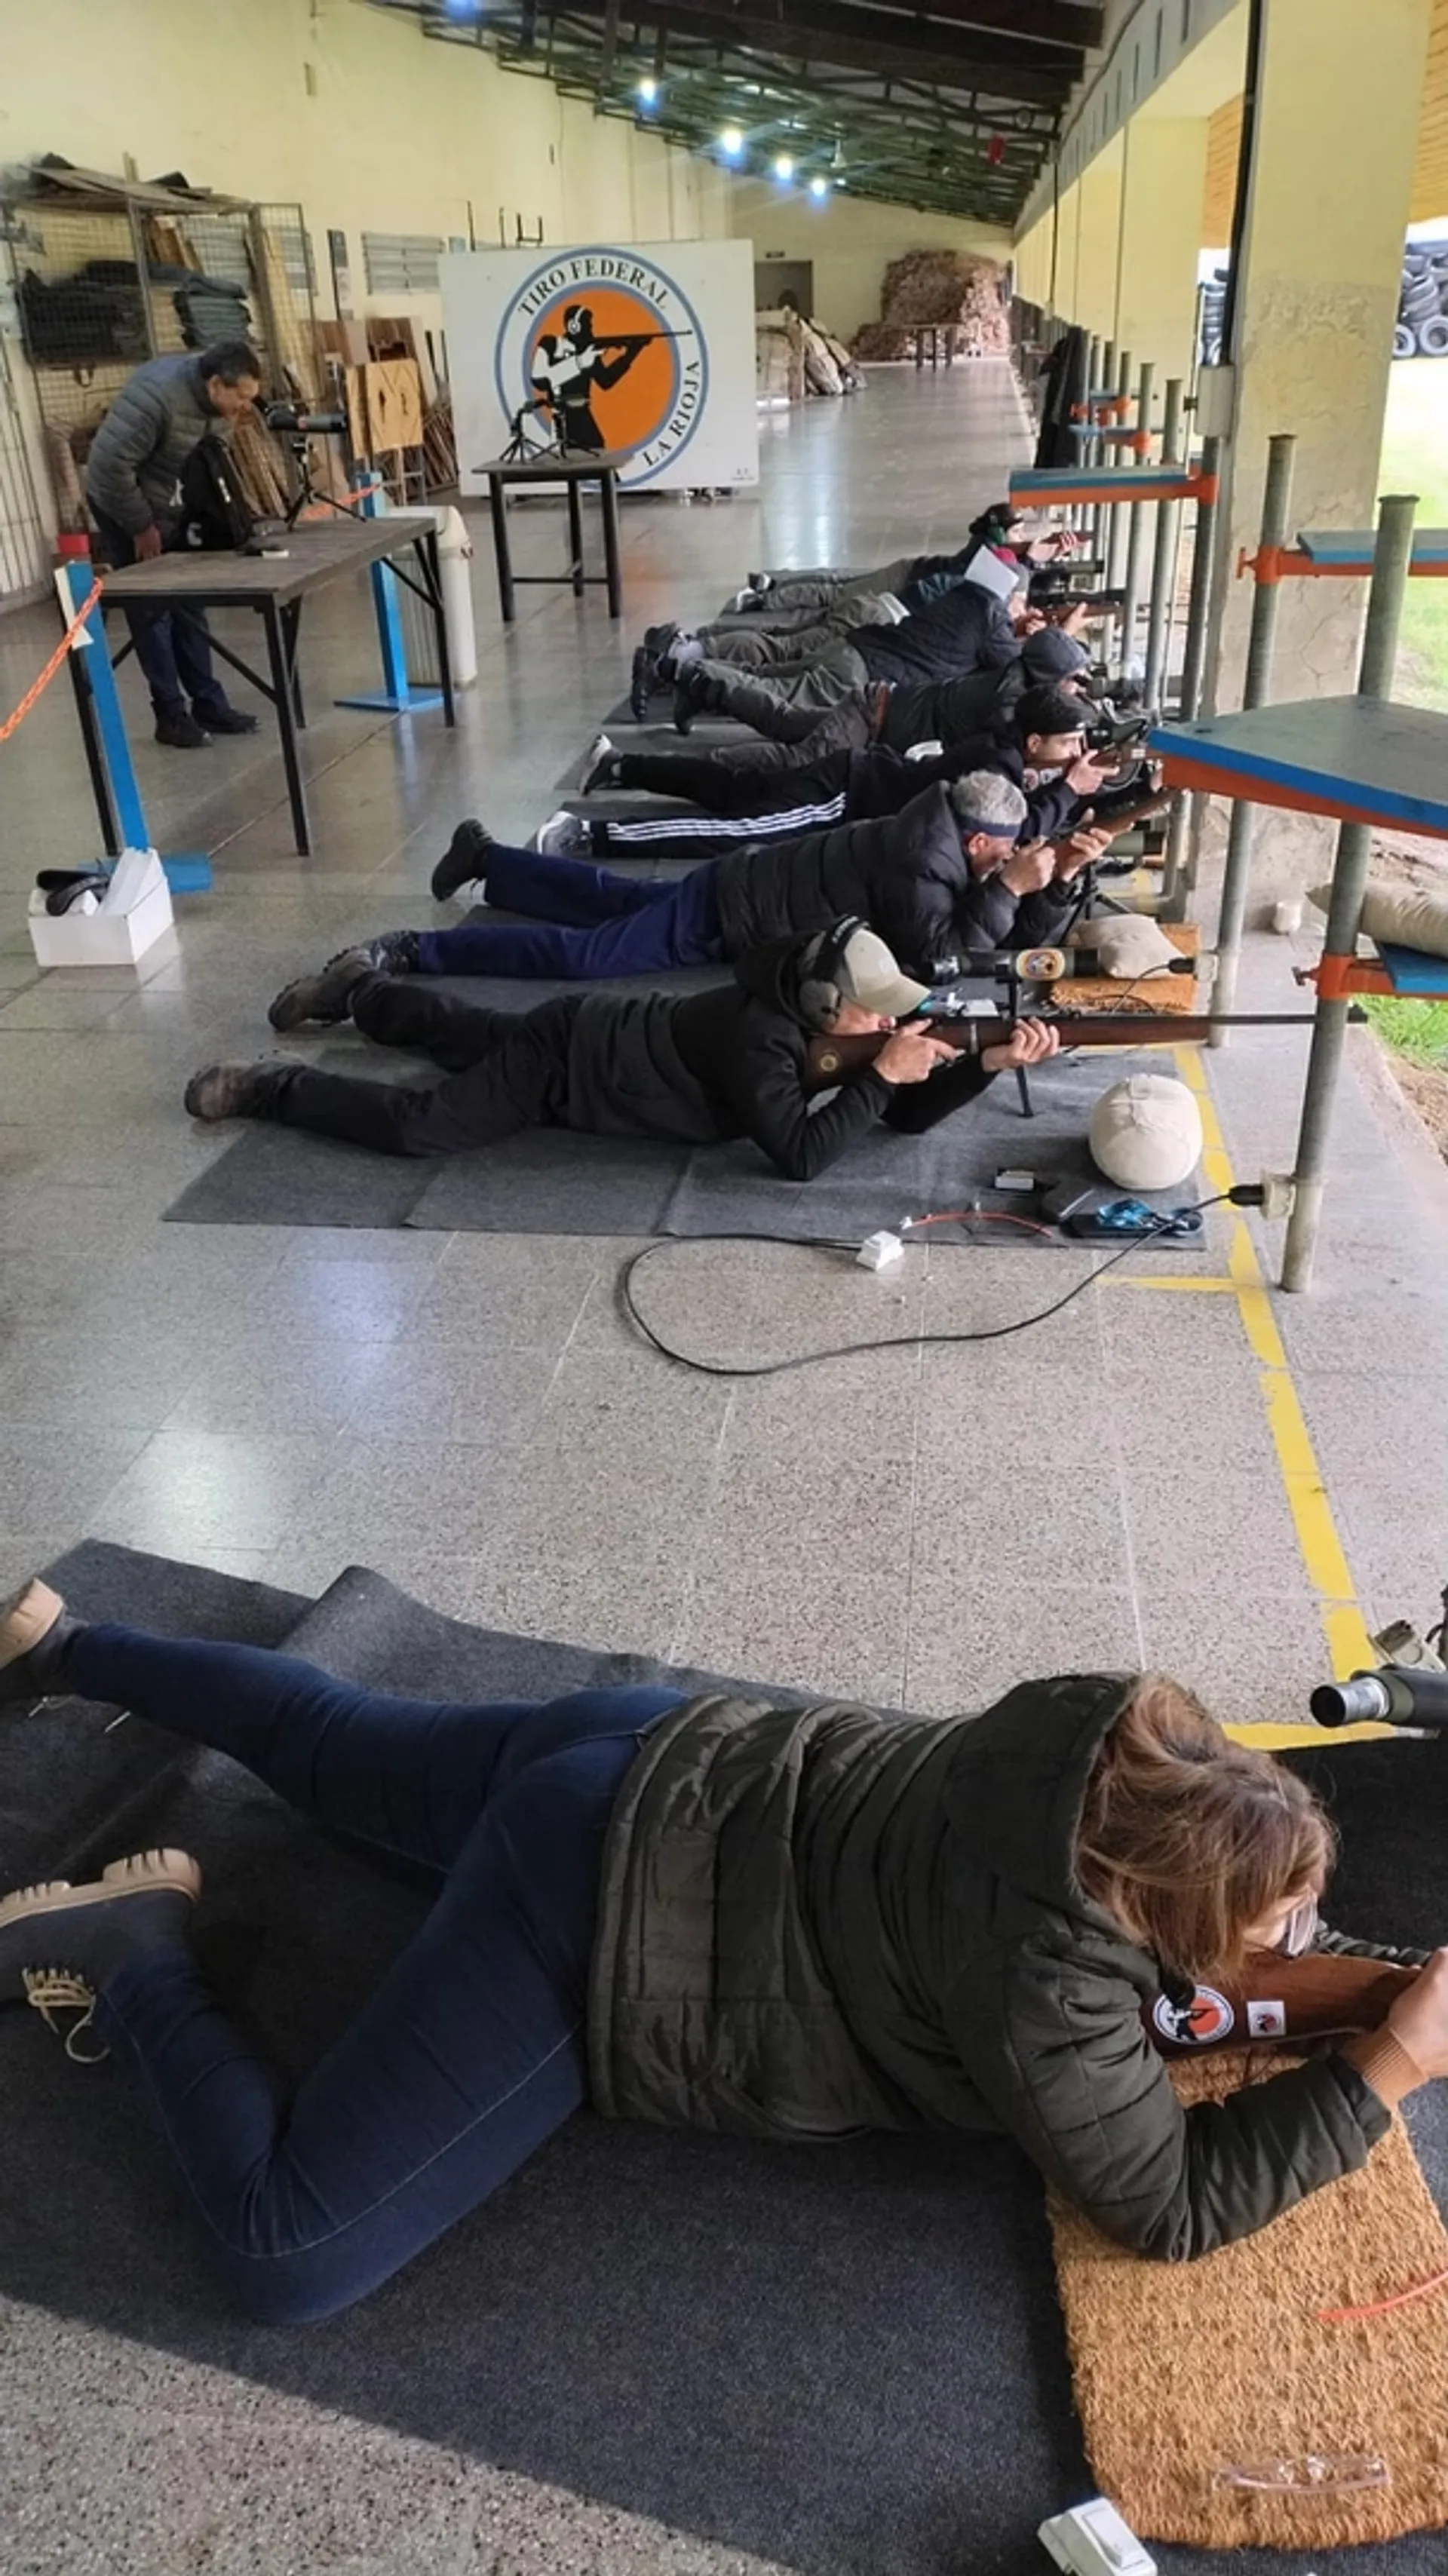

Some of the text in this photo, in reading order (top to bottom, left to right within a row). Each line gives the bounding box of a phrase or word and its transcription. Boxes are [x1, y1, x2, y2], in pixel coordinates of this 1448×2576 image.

[518, 258, 669, 316] TIRO FEDERAL
[642, 360, 700, 467] LA RIOJA
